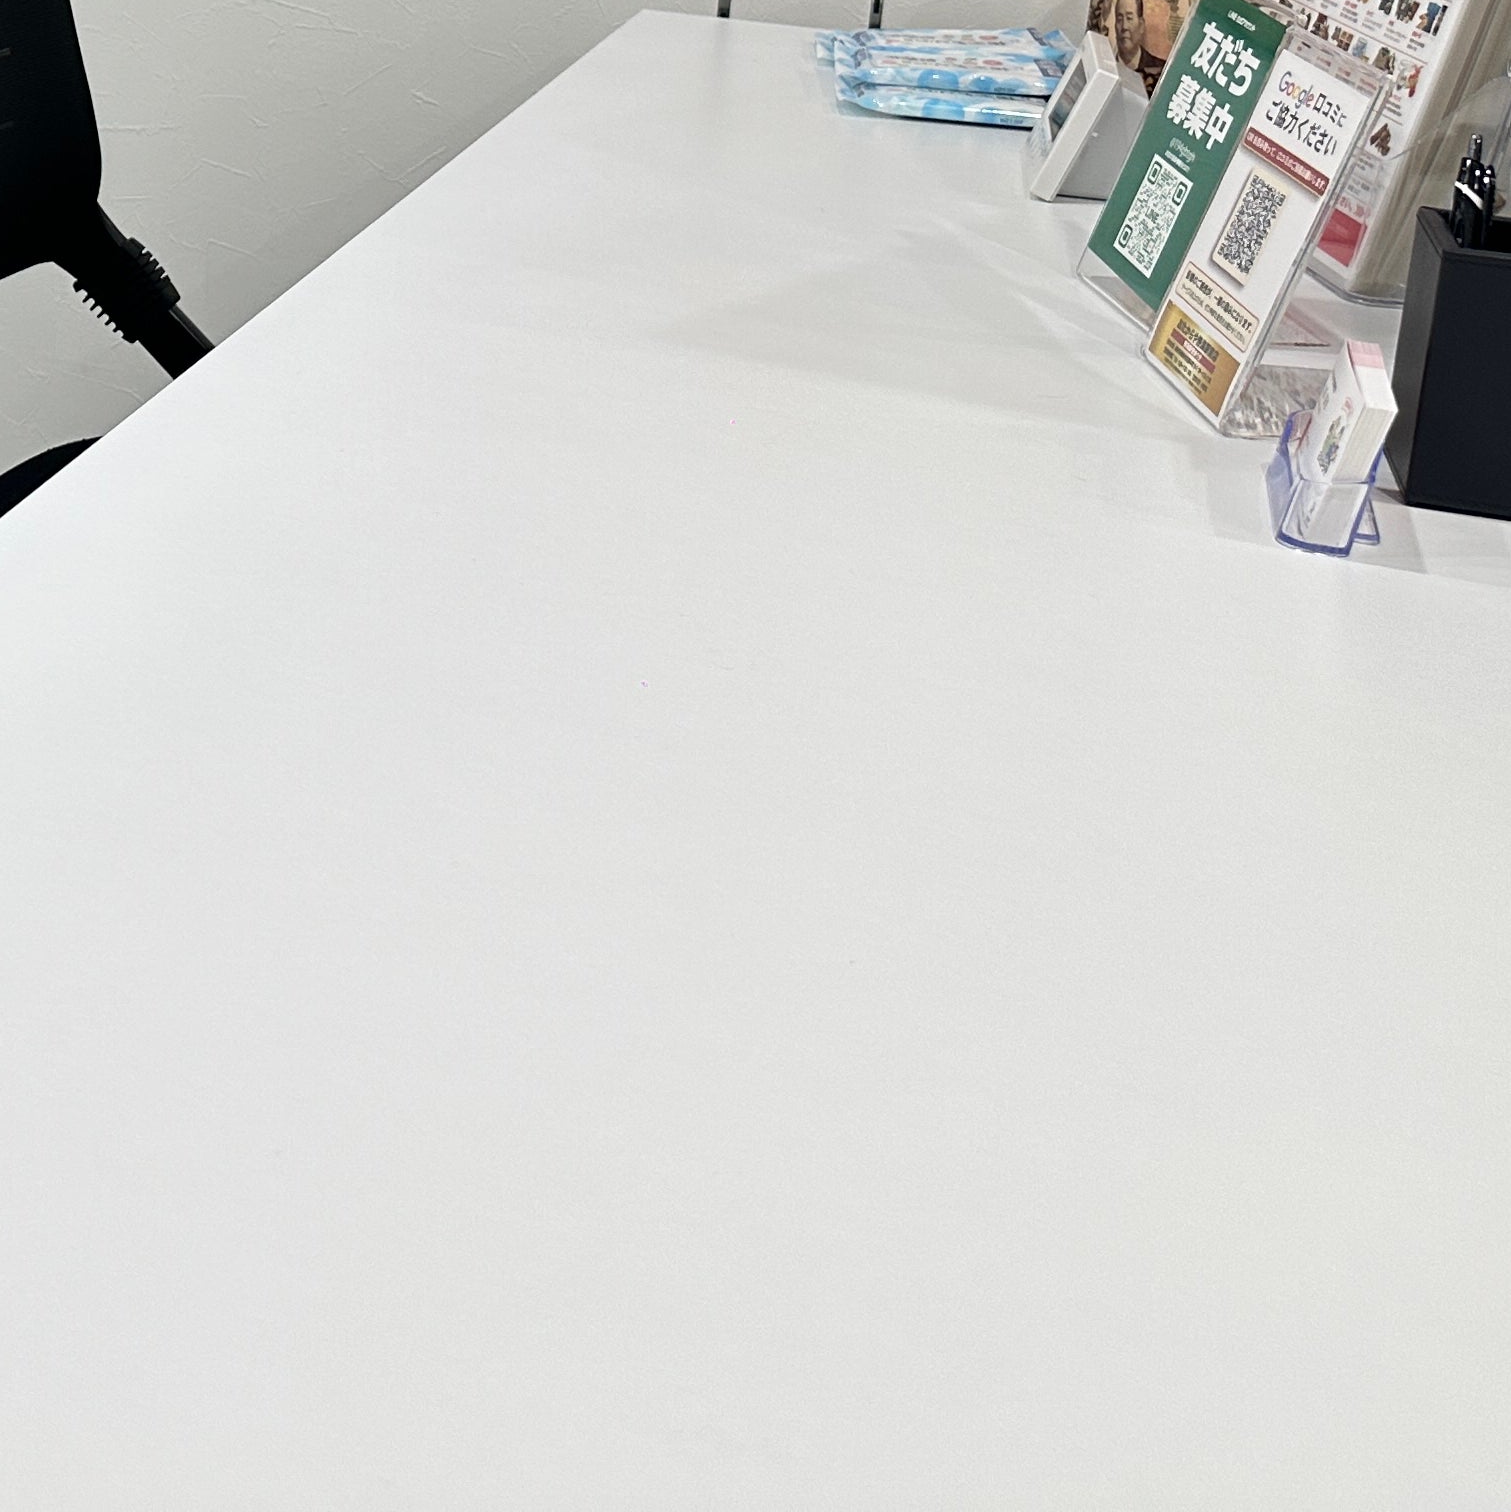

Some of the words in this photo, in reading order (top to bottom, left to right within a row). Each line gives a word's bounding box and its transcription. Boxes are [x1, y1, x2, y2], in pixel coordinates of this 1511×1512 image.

[1191, 22, 1260, 96] 友だち
[1167, 74, 1234, 150] 募集中
[1265, 100, 1337, 156] ご協力ください
